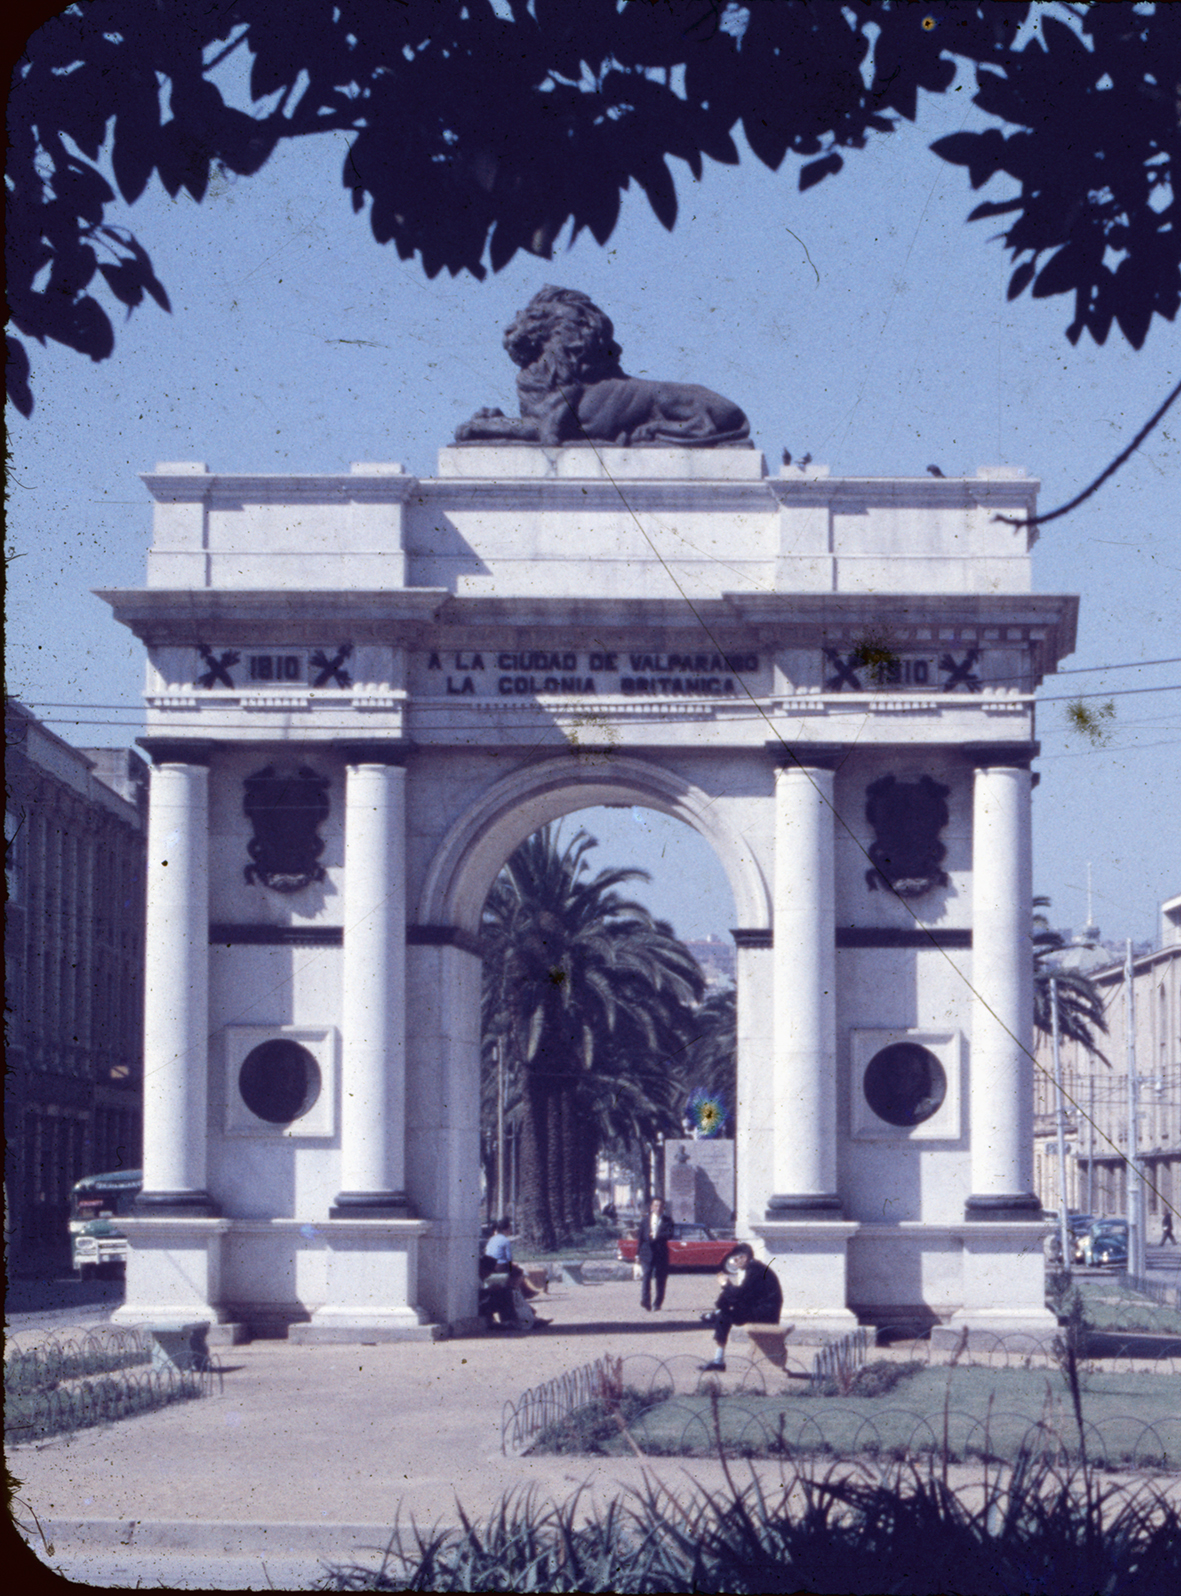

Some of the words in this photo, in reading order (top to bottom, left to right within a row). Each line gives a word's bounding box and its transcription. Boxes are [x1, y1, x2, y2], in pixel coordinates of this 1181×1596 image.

[250, 655, 299, 680] 1810
[428, 652, 443, 671] A
[455, 653, 485, 671] LA
[499, 653, 577, 671] CIUDAD
[589, 653, 618, 671] DE
[446, 676, 475, 695] LA
[499, 676, 596, 695] COLONIA
[621, 677, 735, 695] BRITANICA
